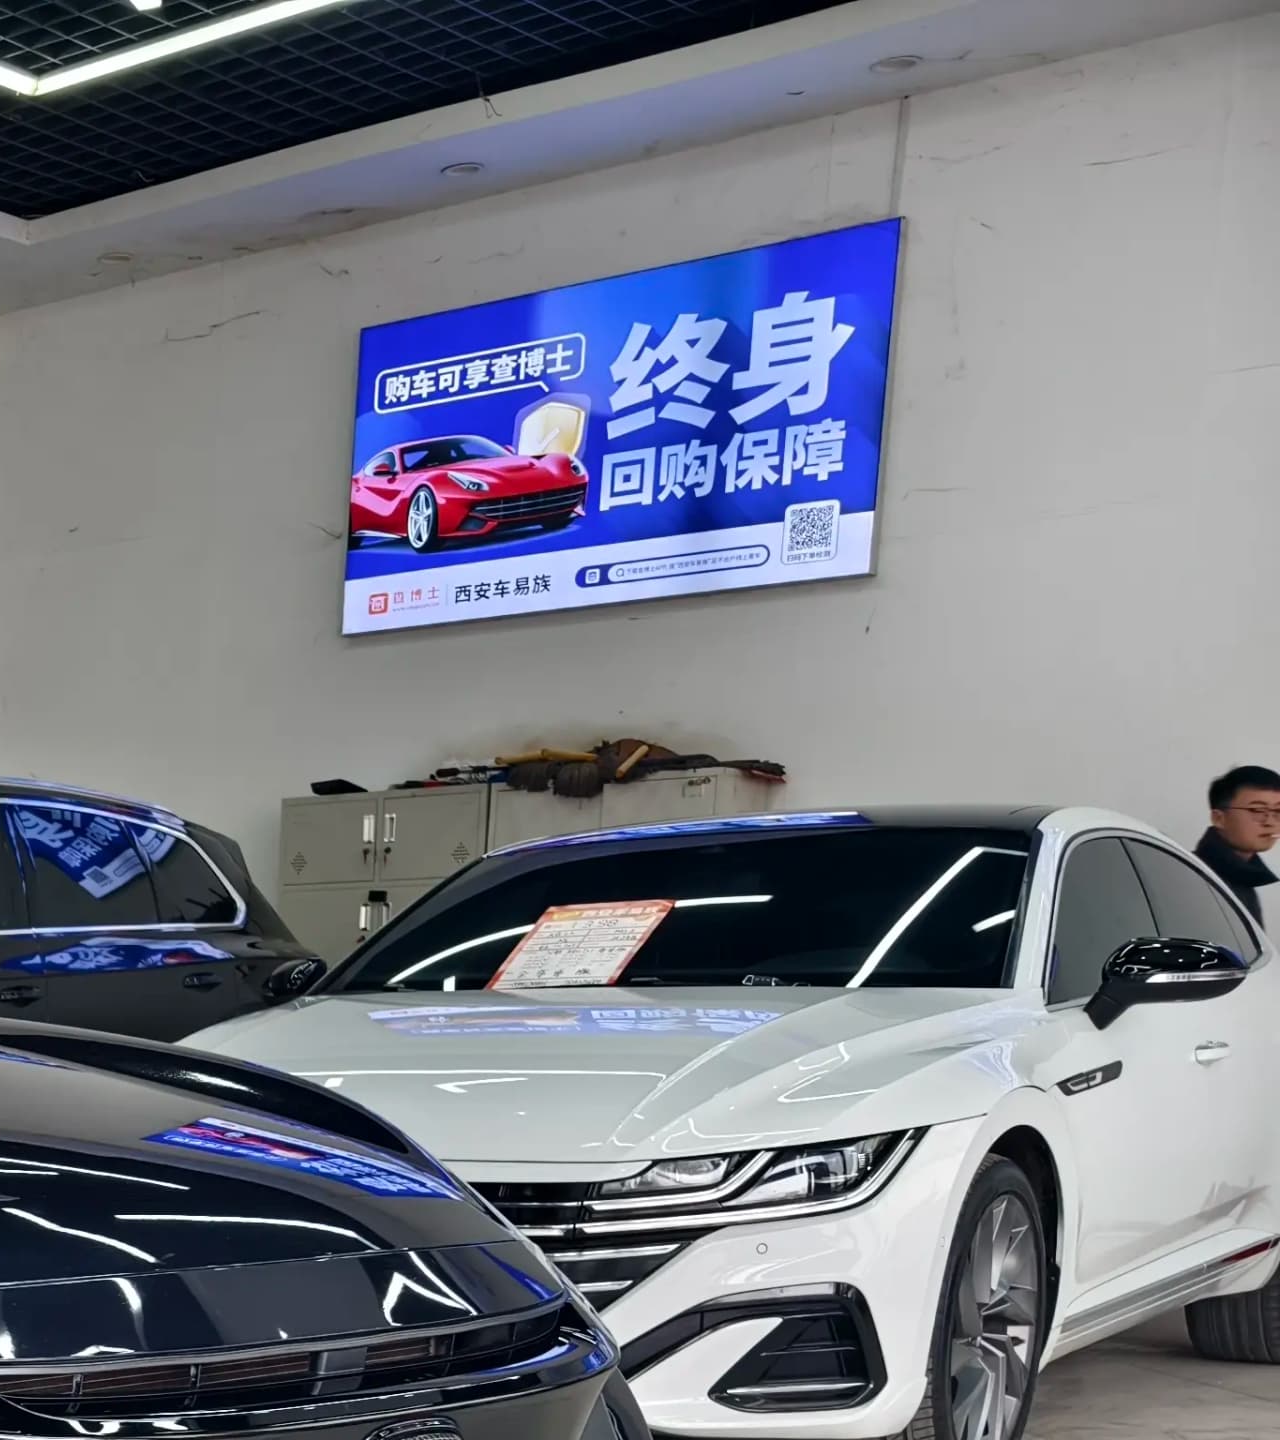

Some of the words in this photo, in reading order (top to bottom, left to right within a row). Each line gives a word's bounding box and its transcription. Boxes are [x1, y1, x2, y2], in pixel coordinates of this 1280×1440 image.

[384, 343, 574, 404] 购车可享查博士
[606, 290, 856, 440] 终身
[599, 418, 847, 512] 回购保障
[454, 573, 552, 604] 西安车易族
